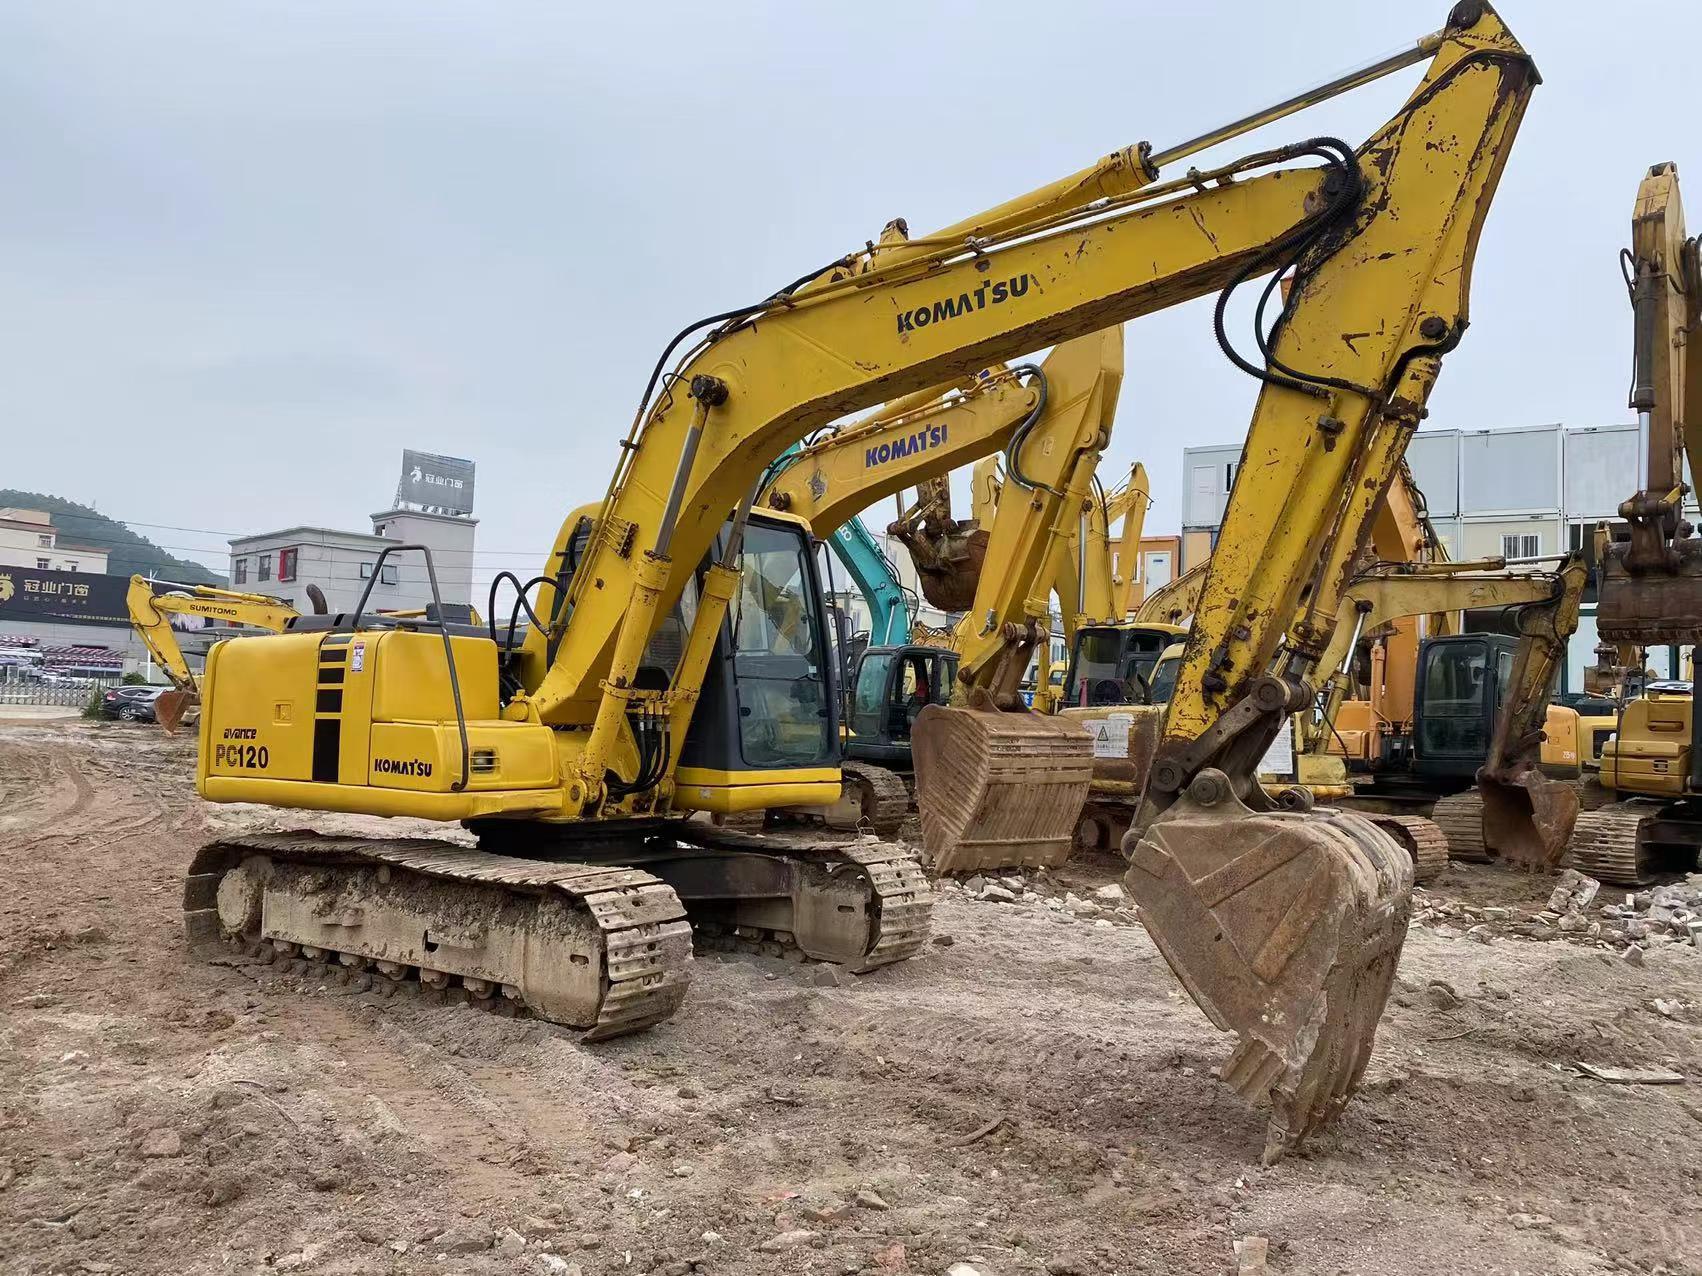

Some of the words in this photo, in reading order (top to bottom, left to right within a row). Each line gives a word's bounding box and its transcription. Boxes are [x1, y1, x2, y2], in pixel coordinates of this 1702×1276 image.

[897, 273, 1029, 334] KOMATSU
[24, 579, 90, 596] 冠业门窗
[189, 604, 238, 616] SUMITOMO
[215, 743, 269, 769] PC120
[374, 758, 432, 777] KOMATSU
